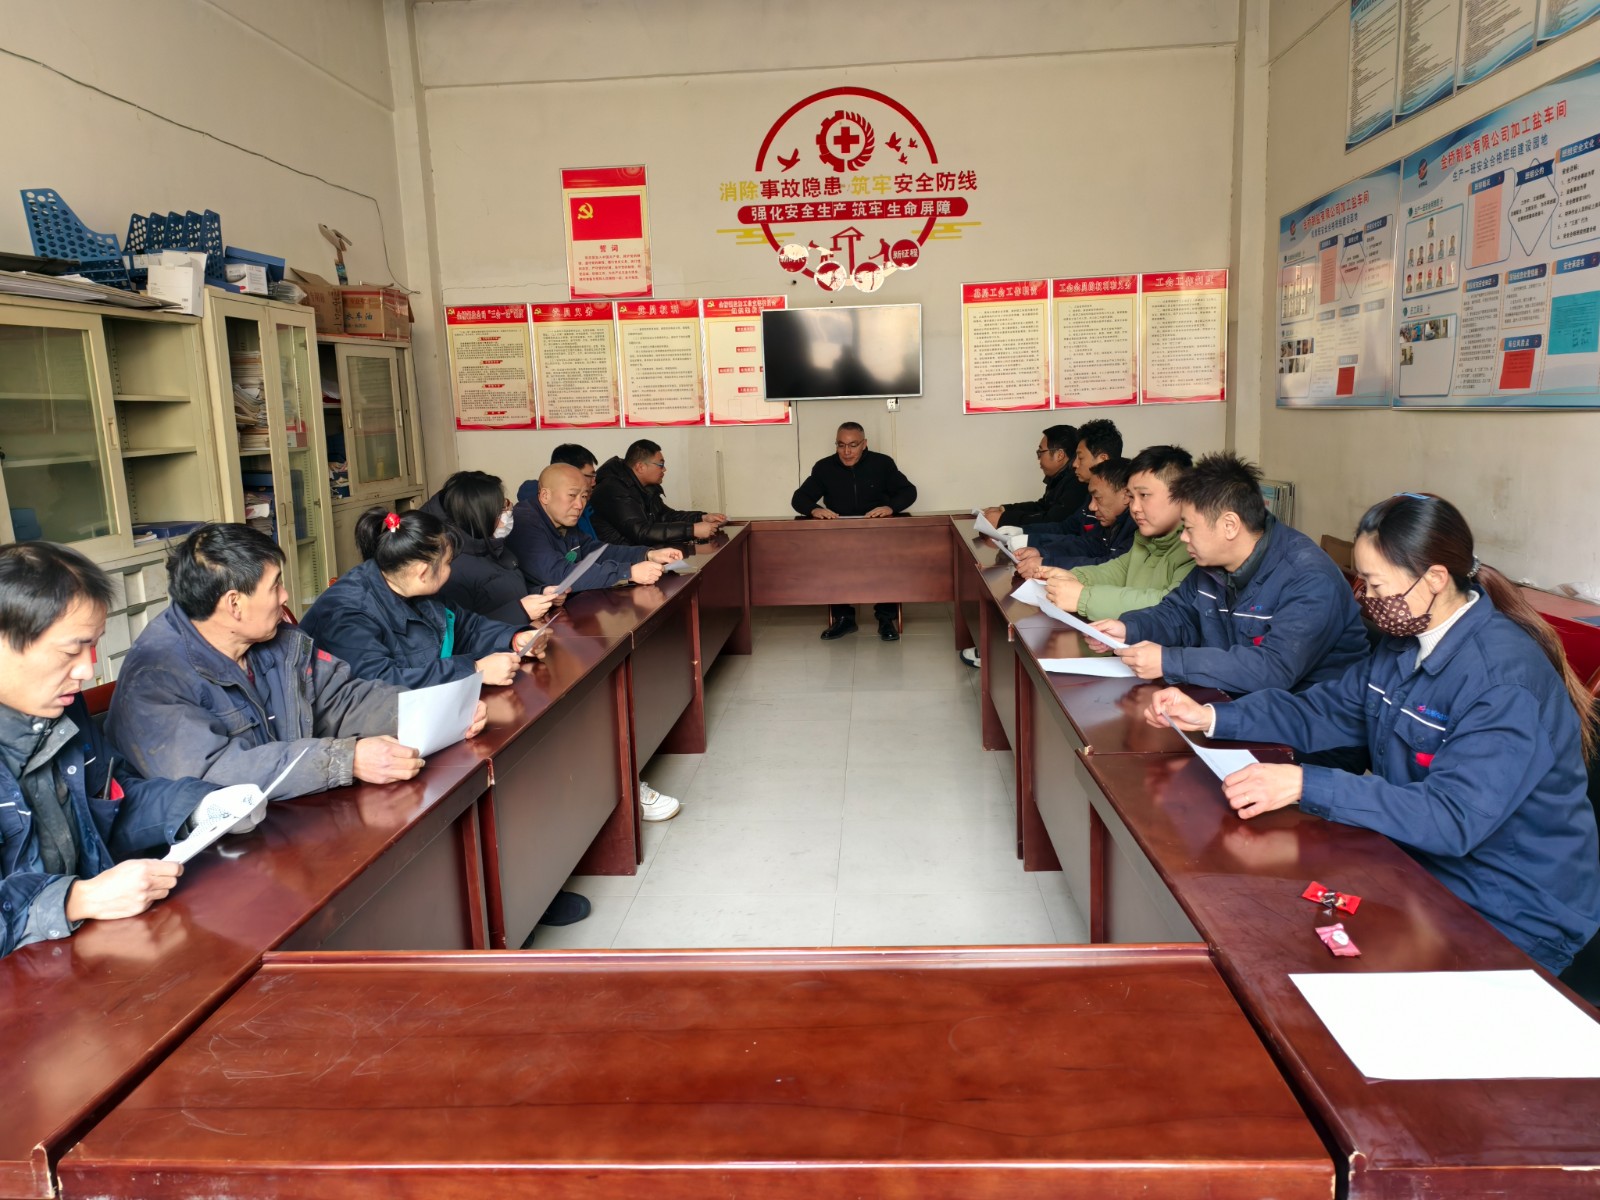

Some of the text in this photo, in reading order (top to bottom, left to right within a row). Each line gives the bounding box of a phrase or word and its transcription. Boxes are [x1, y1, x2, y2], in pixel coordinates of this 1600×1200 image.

[1440, 100, 1568, 170] 金桥制盐有限公司加工盐车间
[1452, 134, 1549, 182] 生产一班安全合格班组建设园地
[719, 170, 978, 202] 消除事故隐患 筑牢安全防线
[751, 200, 952, 221] 强化安全生产 筑牢生命屏障
[893, 249, 919, 259] 新征程
